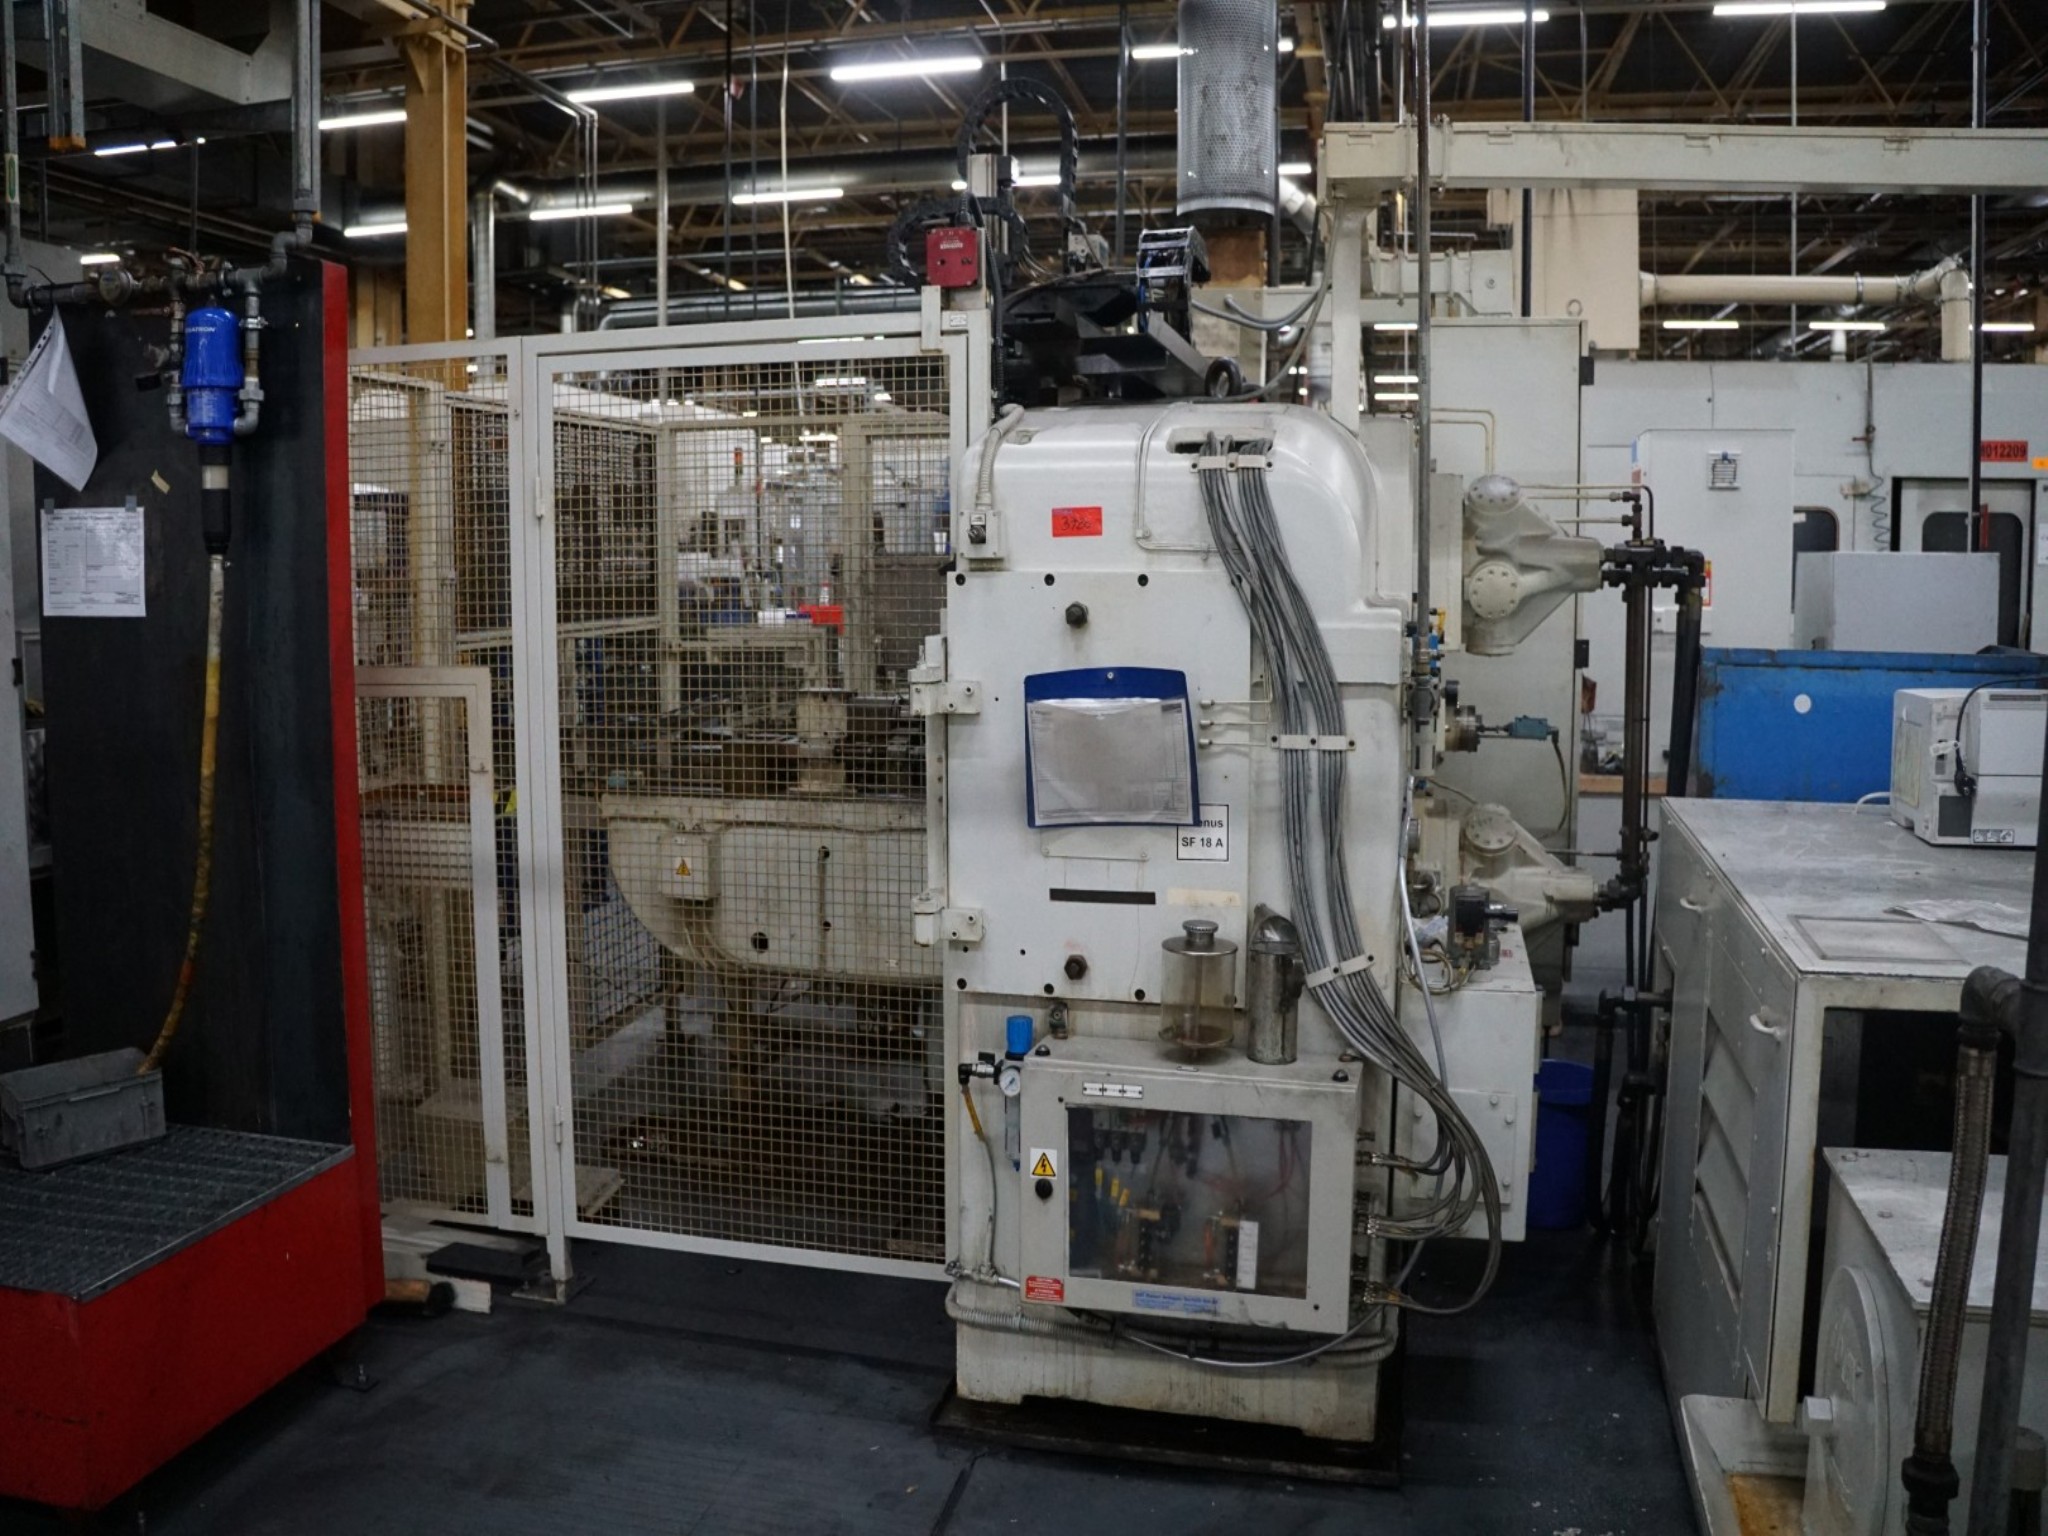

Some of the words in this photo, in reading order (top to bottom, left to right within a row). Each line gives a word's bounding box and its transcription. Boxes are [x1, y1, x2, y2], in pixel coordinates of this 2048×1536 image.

[1200, 819, 1224, 828] nus
[1181, 836, 1196, 848] SF
[1200, 836, 1212, 848] 18
[1215, 838, 1224, 848] A
